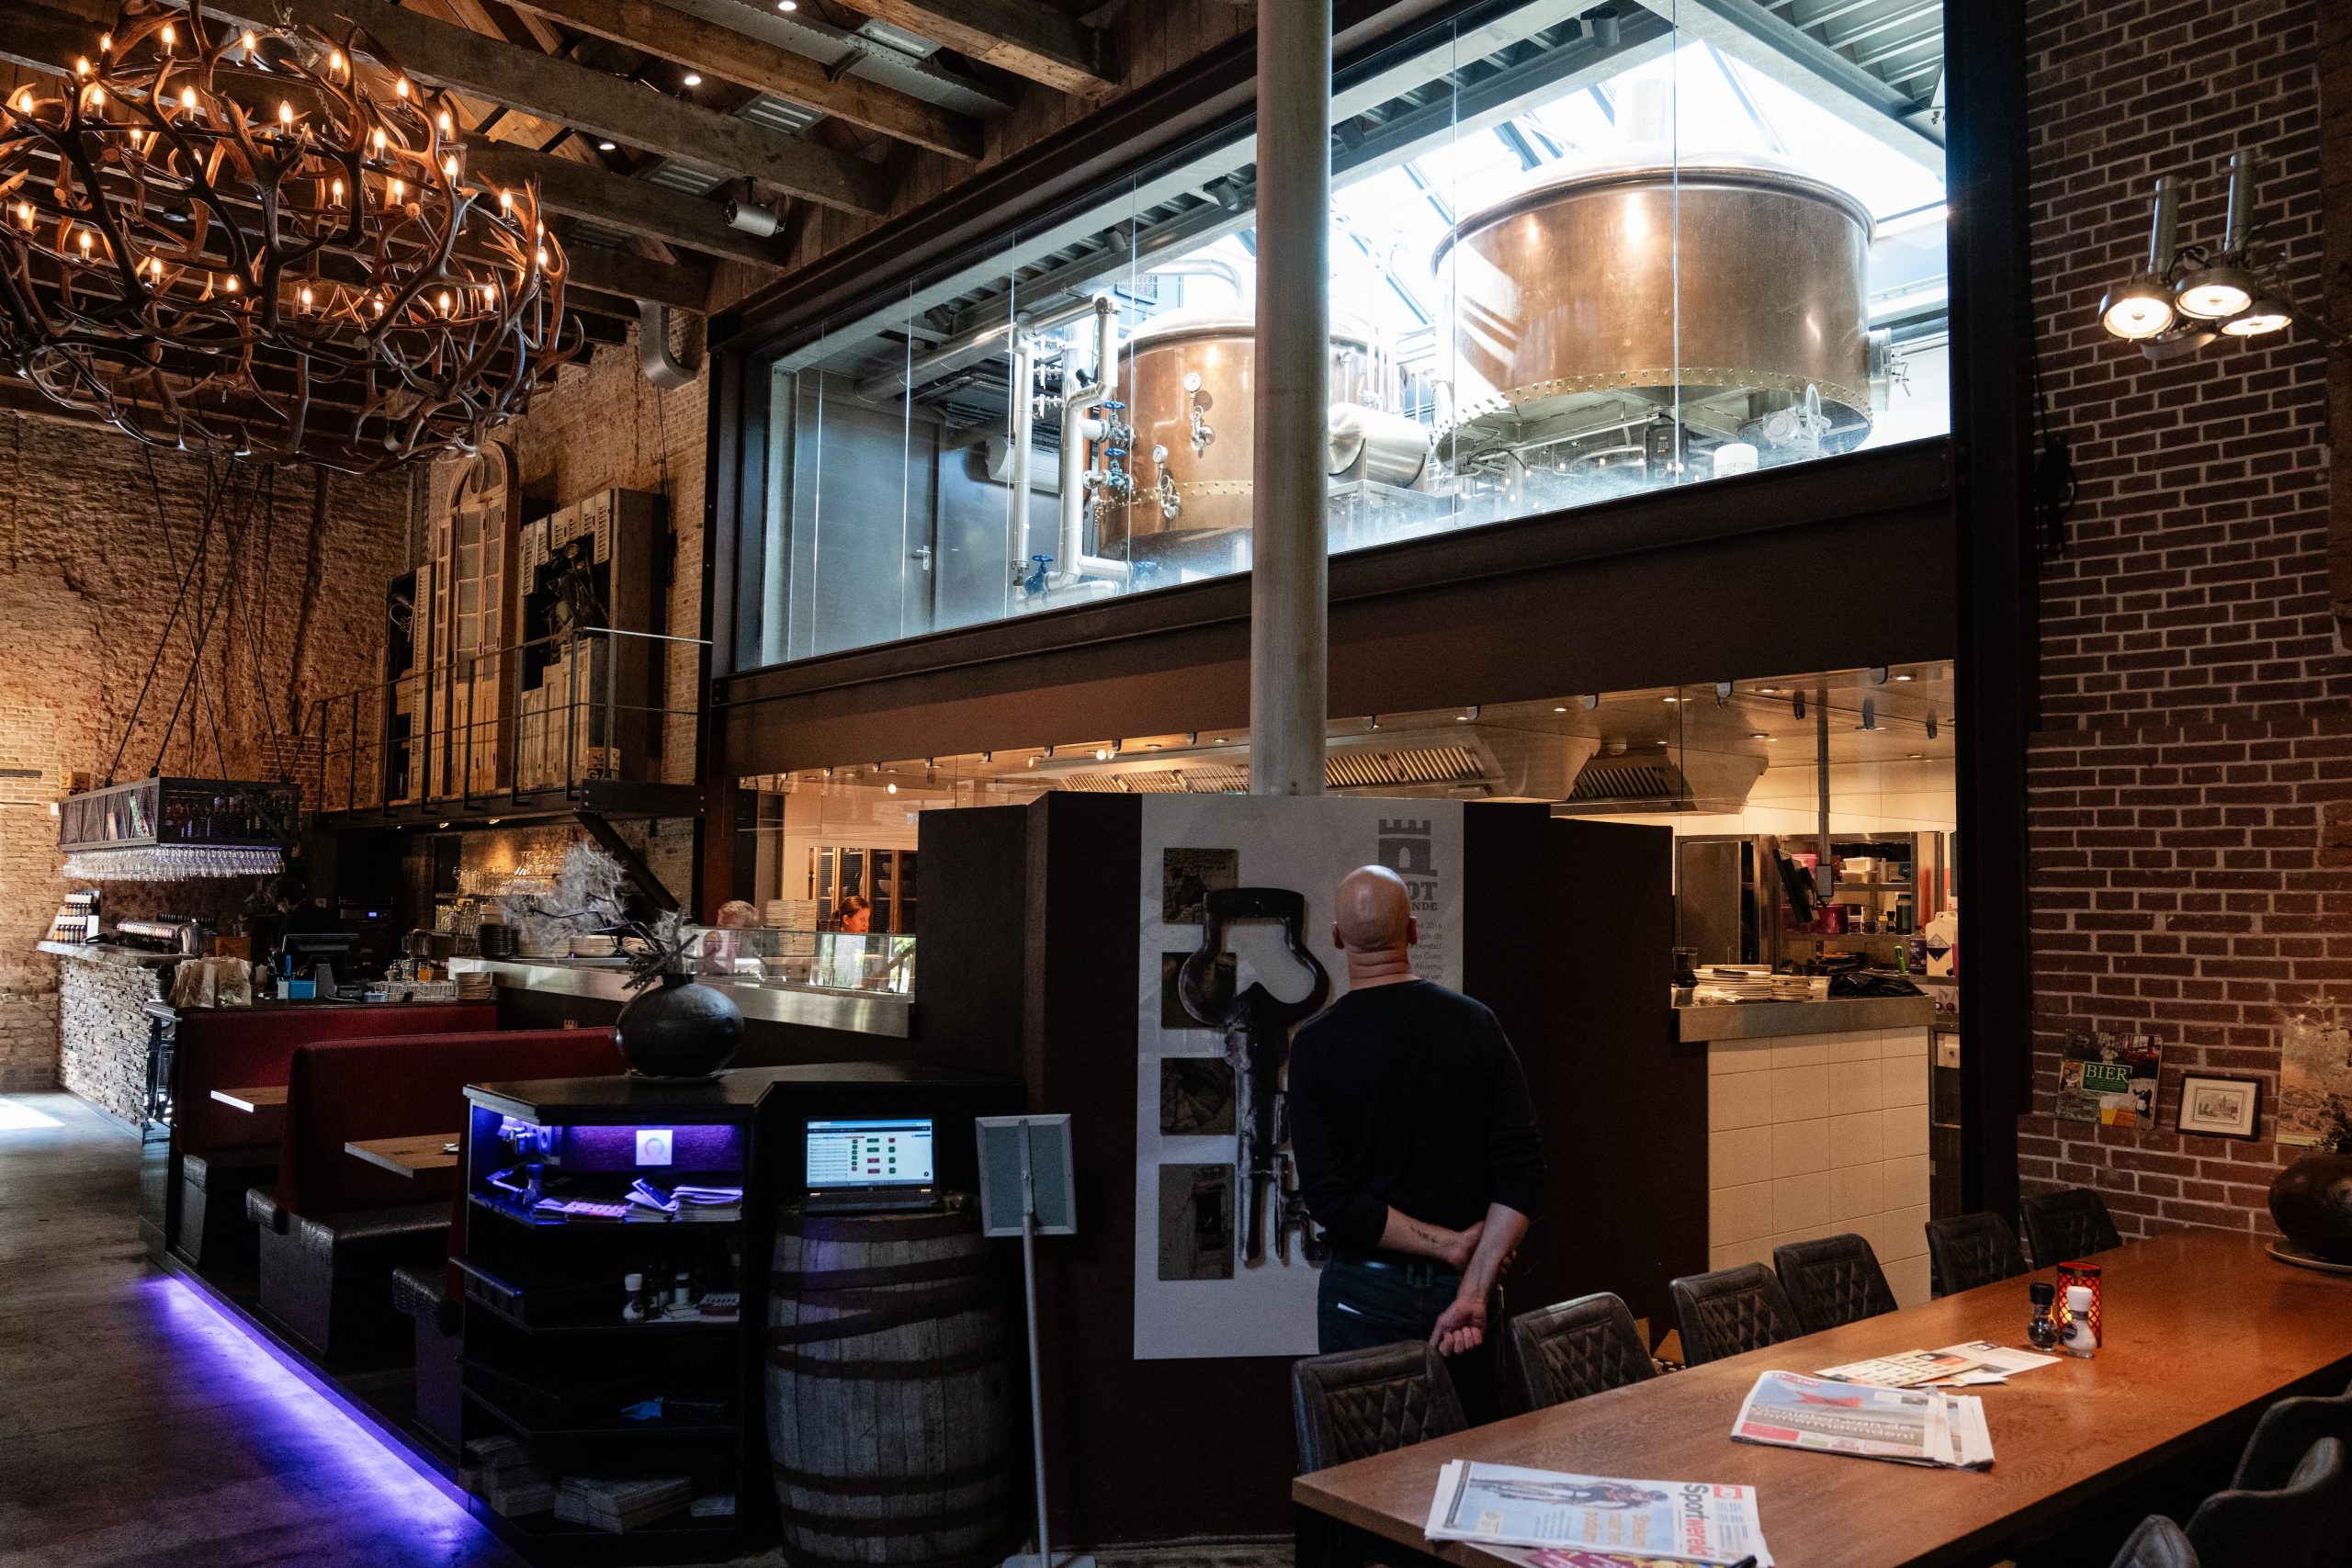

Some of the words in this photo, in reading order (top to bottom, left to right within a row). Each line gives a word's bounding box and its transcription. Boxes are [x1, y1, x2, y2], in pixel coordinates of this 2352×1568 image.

[1405, 881, 1438, 900] OT
[1411, 902, 1438, 911] NDE
[2086, 1064, 2130, 1083] BIER
[1679, 1484, 1714, 1557] Sportwereld
